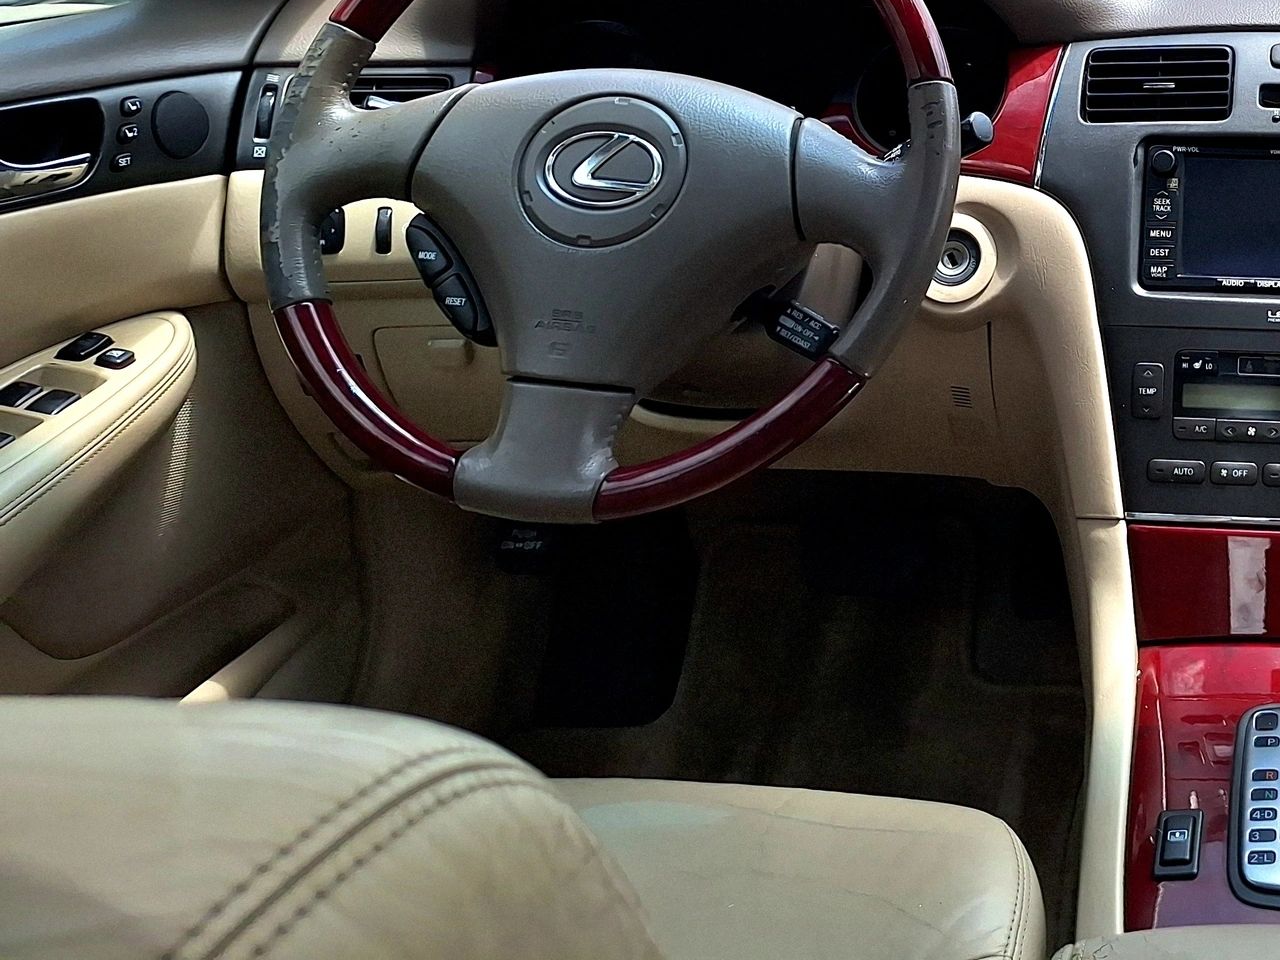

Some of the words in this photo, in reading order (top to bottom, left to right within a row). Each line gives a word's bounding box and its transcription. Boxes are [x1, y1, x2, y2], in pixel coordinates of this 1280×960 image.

[118, 157, 131, 166] SET
[1149, 229, 1172, 238] MENU
[418, 251, 437, 260] MODE
[1149, 248, 1170, 256] DEST
[445, 297, 467, 306] RESET
[1138, 387, 1157, 395] TEMP
[1194, 425, 1207, 434] A/C
[1173, 467, 1194, 476] AUTO
[1232, 469, 1248, 478] OFF
[1252, 810, 1273, 819] 4-D
[1252, 831, 1260, 840] 3
[1250, 853, 1272, 863] 2-L
